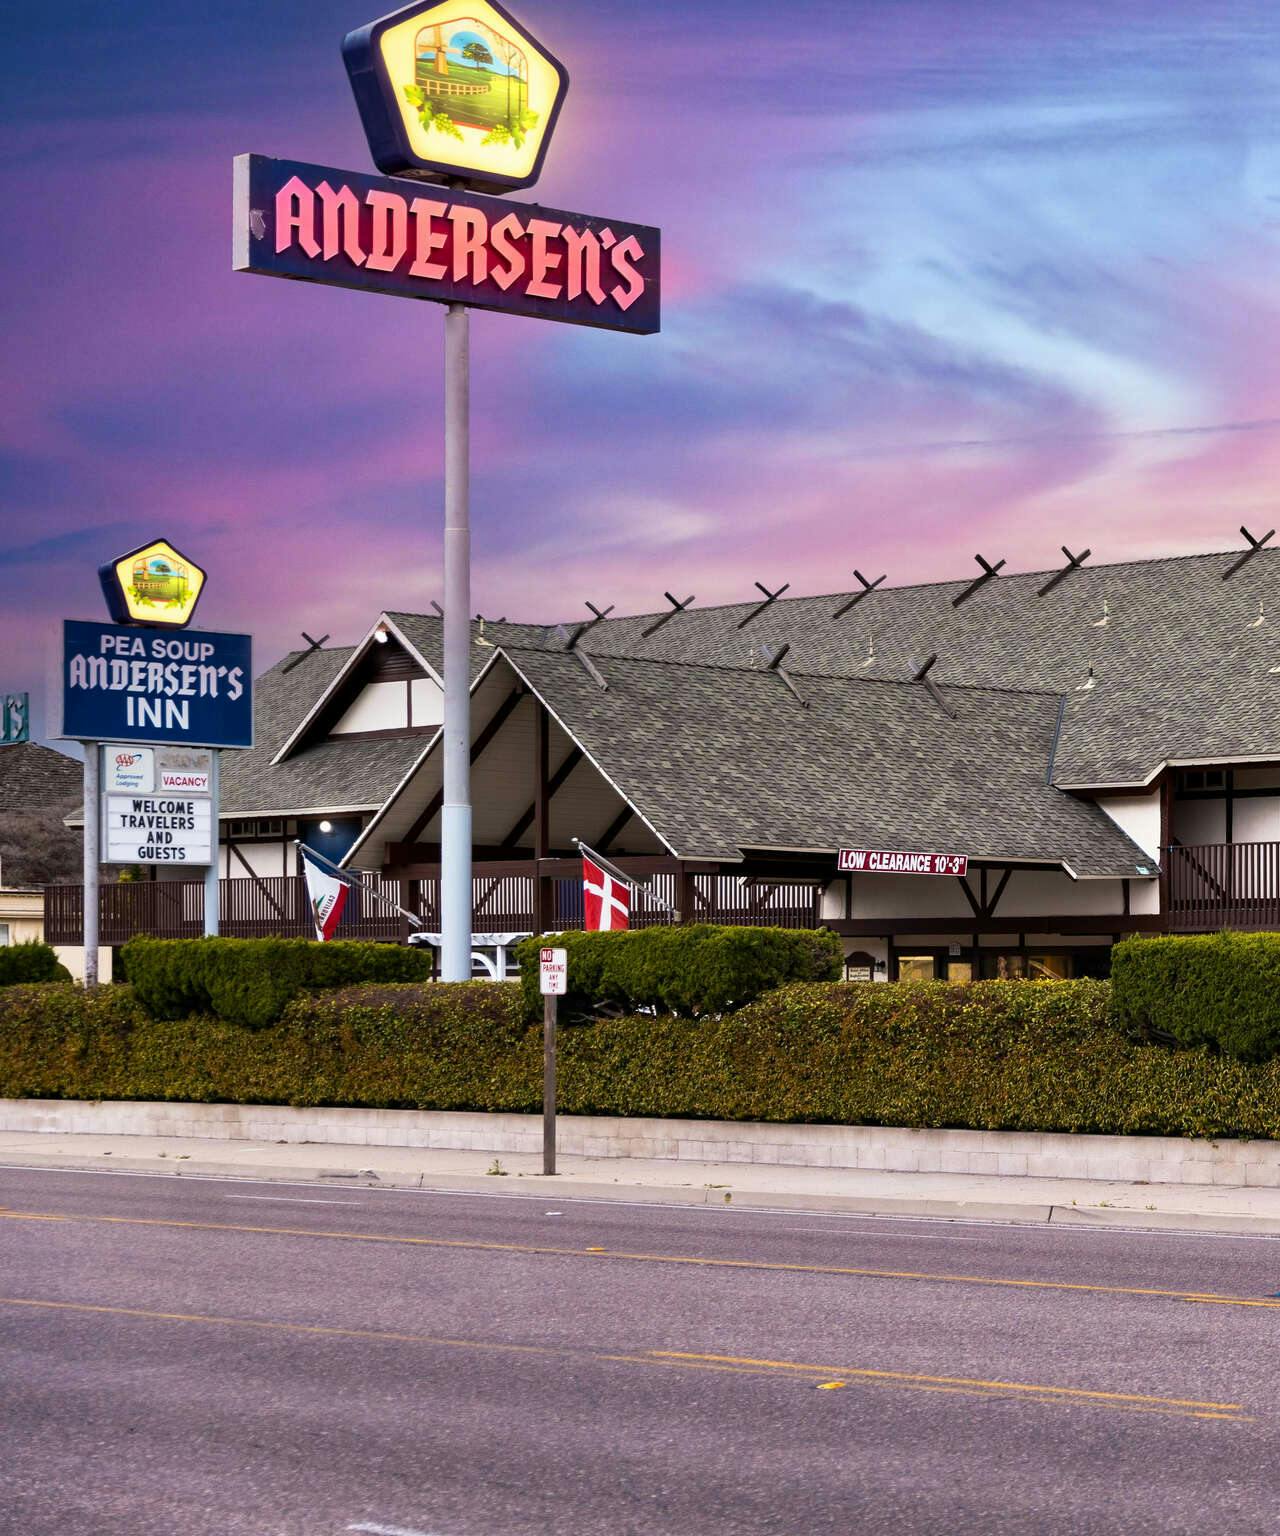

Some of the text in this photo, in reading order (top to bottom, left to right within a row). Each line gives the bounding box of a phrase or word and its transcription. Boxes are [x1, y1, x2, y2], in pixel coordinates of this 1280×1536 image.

[275, 175, 646, 311] ANDERSEN'S
[100, 635, 215, 661] PEA SOUP
[70, 653, 243, 701] ANDERSEN'S
[127, 696, 189, 729] INN
[163, 776, 207, 787] VACANCY
[132, 800, 194, 814] WELCOME
[120, 815, 195, 830] TRAVELERS
[147, 831, 173, 844] AND
[138, 846, 185, 860] GUESTS
[841, 851, 964, 873] LOW CLEARANCE 10'-3"
[542, 950, 552, 961] NO
[543, 964, 565, 972] PARKING
